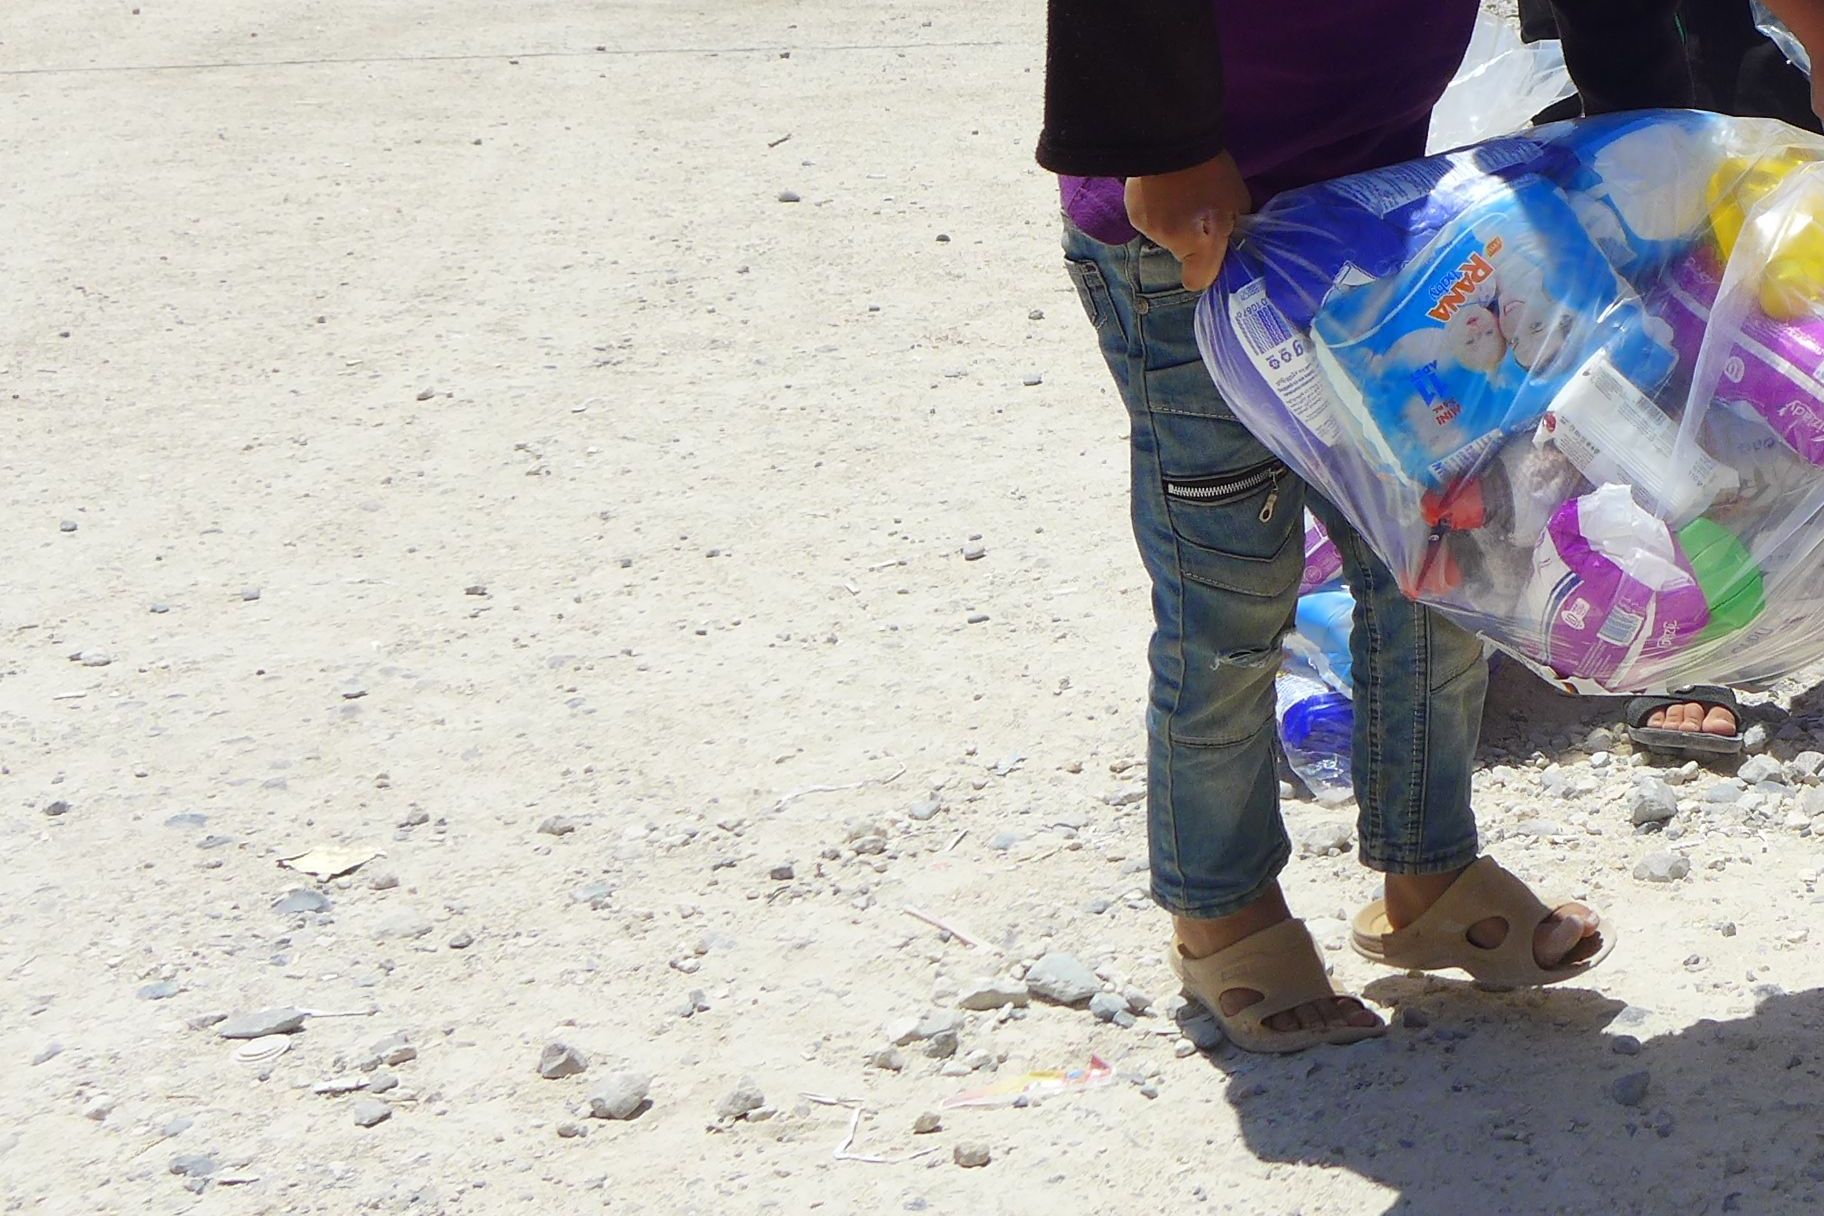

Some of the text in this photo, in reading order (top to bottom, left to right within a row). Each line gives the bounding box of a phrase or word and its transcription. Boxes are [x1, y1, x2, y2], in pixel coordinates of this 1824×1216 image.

[1425, 251, 1496, 324] RANA
[1429, 268, 1461, 302] baby
[1435, 401, 1462, 426] MINI
